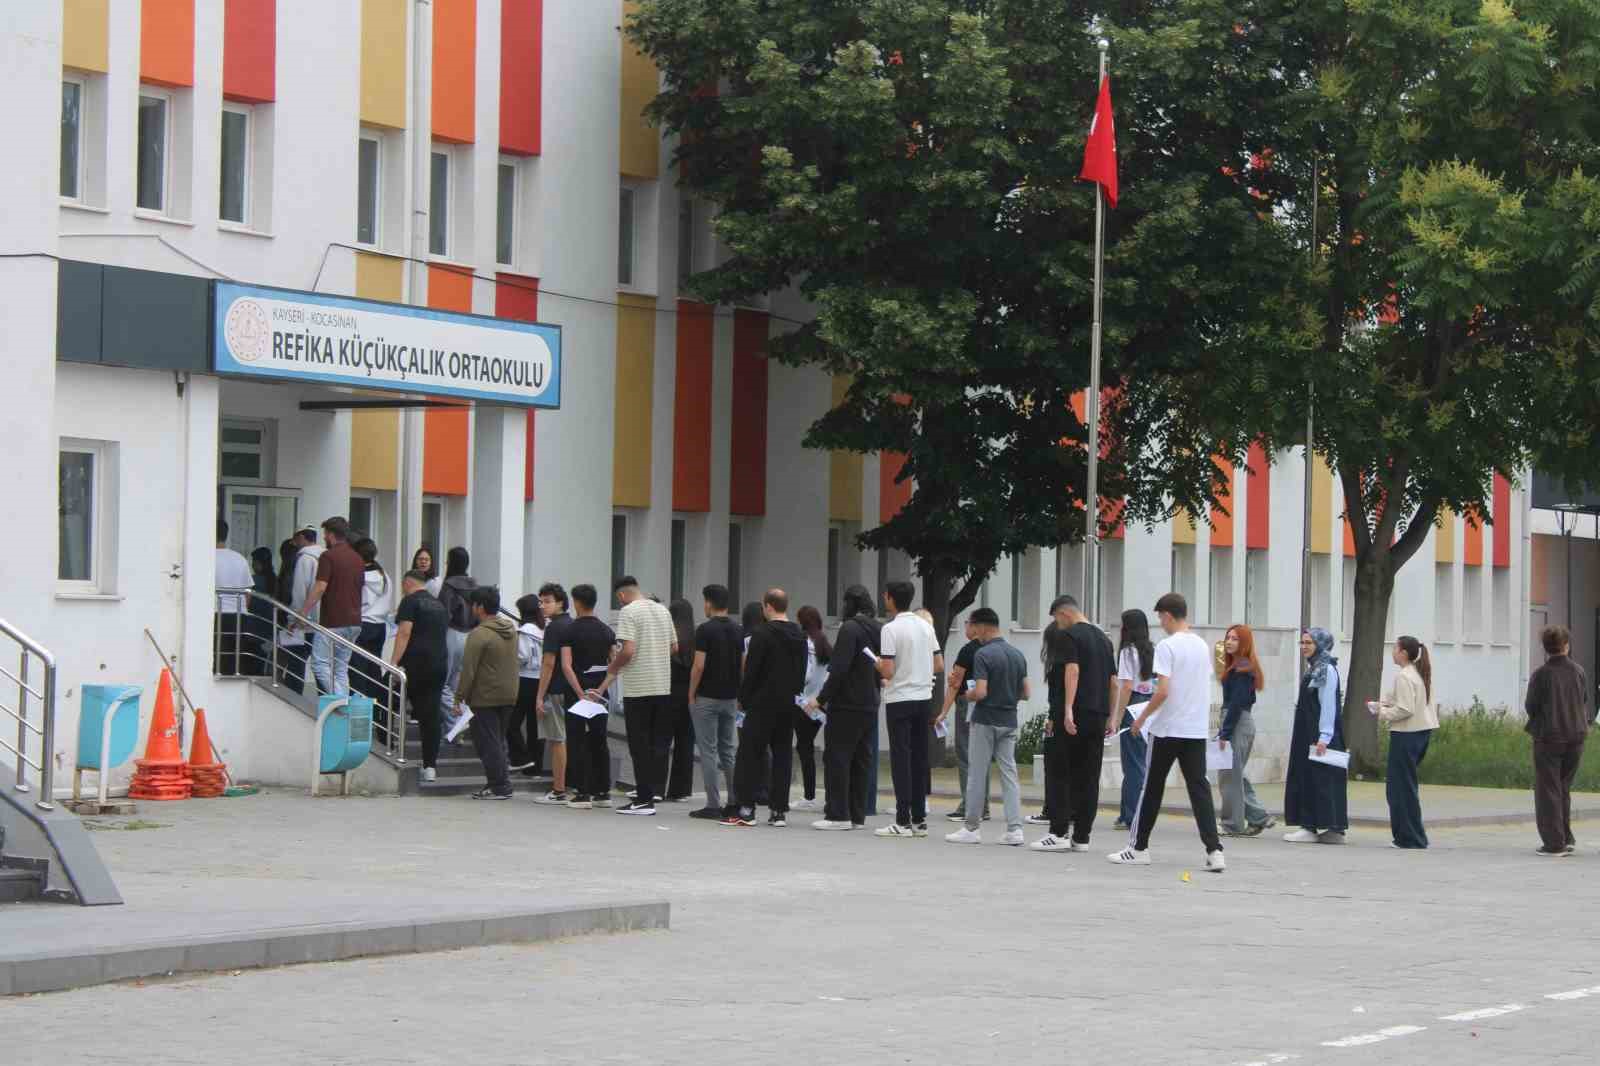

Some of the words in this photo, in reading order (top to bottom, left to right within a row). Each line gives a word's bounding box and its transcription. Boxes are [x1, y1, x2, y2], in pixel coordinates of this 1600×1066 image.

[273, 328, 334, 364] REFİKA
[340, 334, 445, 380] KÜÇÜKÇALIK
[448, 351, 543, 388] ORTAOKULU
